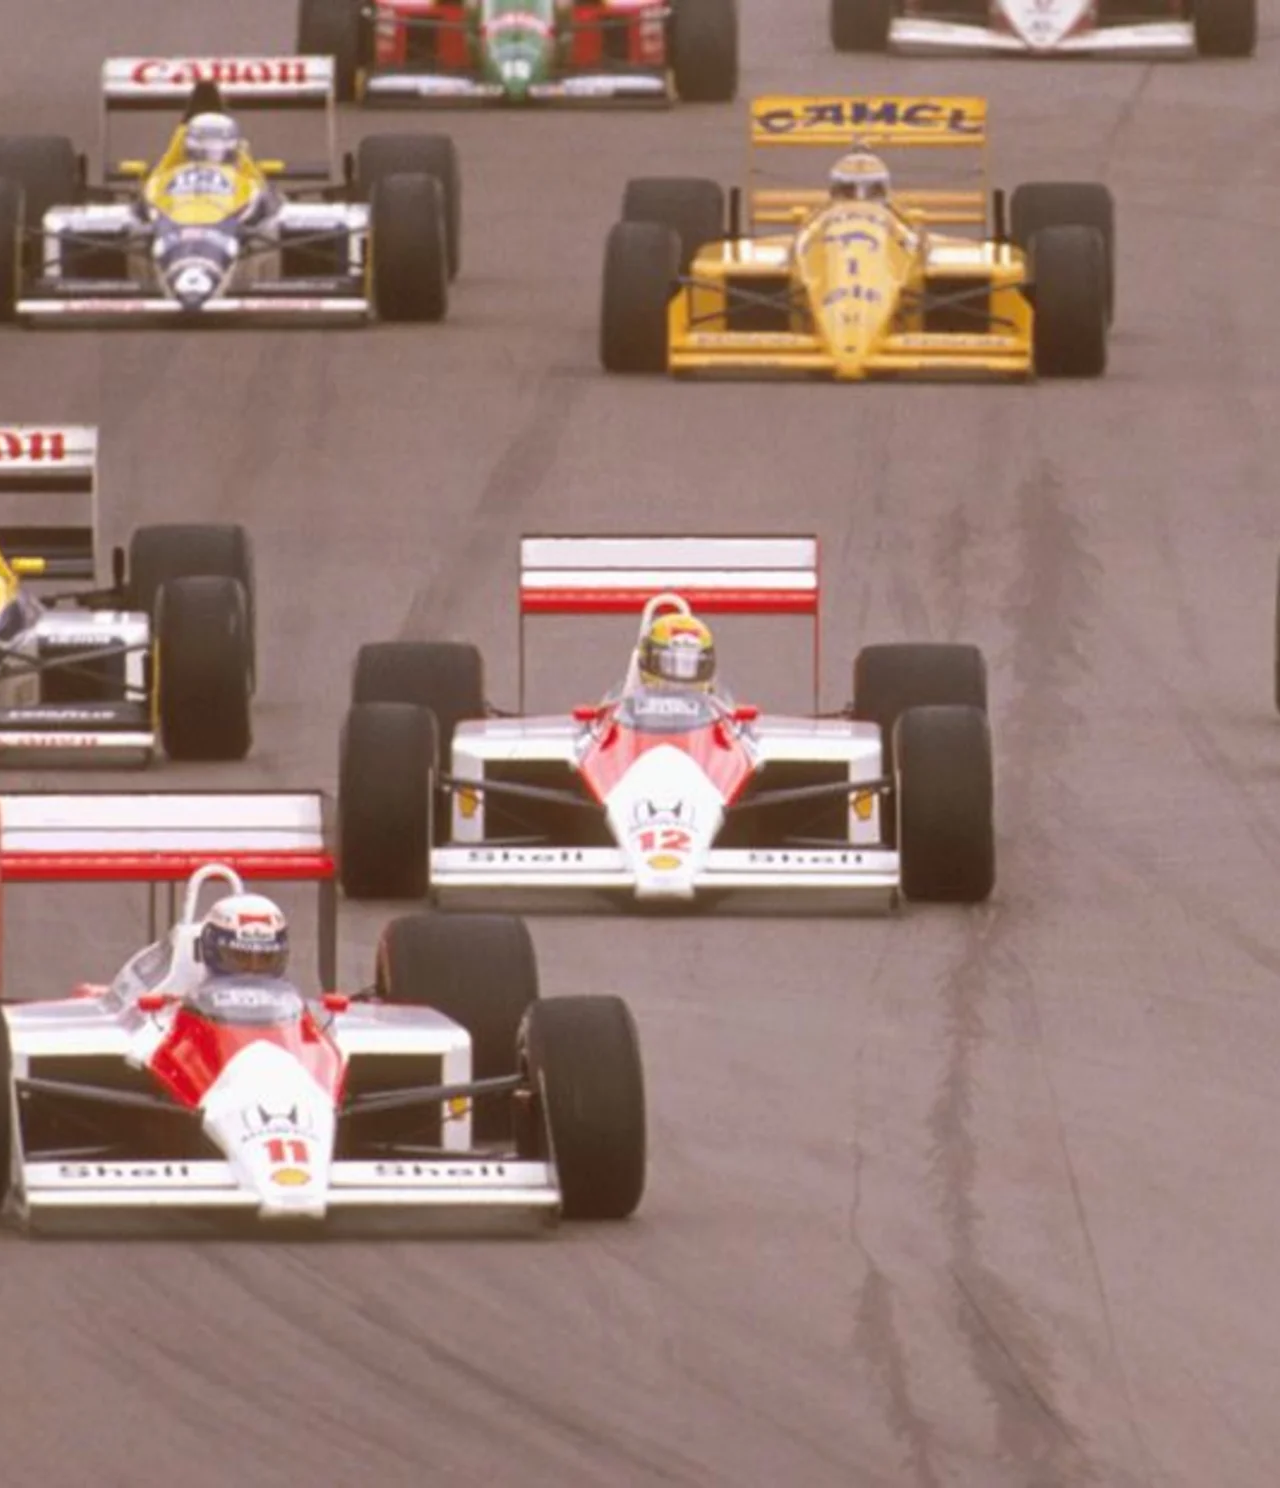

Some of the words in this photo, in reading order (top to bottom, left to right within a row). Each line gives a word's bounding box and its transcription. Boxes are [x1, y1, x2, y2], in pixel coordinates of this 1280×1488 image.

[130, 61, 308, 84] Canon
[758, 102, 984, 134] CAMEL
[639, 830, 691, 853] 12
[468, 851, 584, 863] Shell
[748, 852, 864, 864] Shell
[263, 1137, 310, 1165] 11
[59, 1164, 190, 1178] Shell
[374, 1163, 506, 1177] Shell
